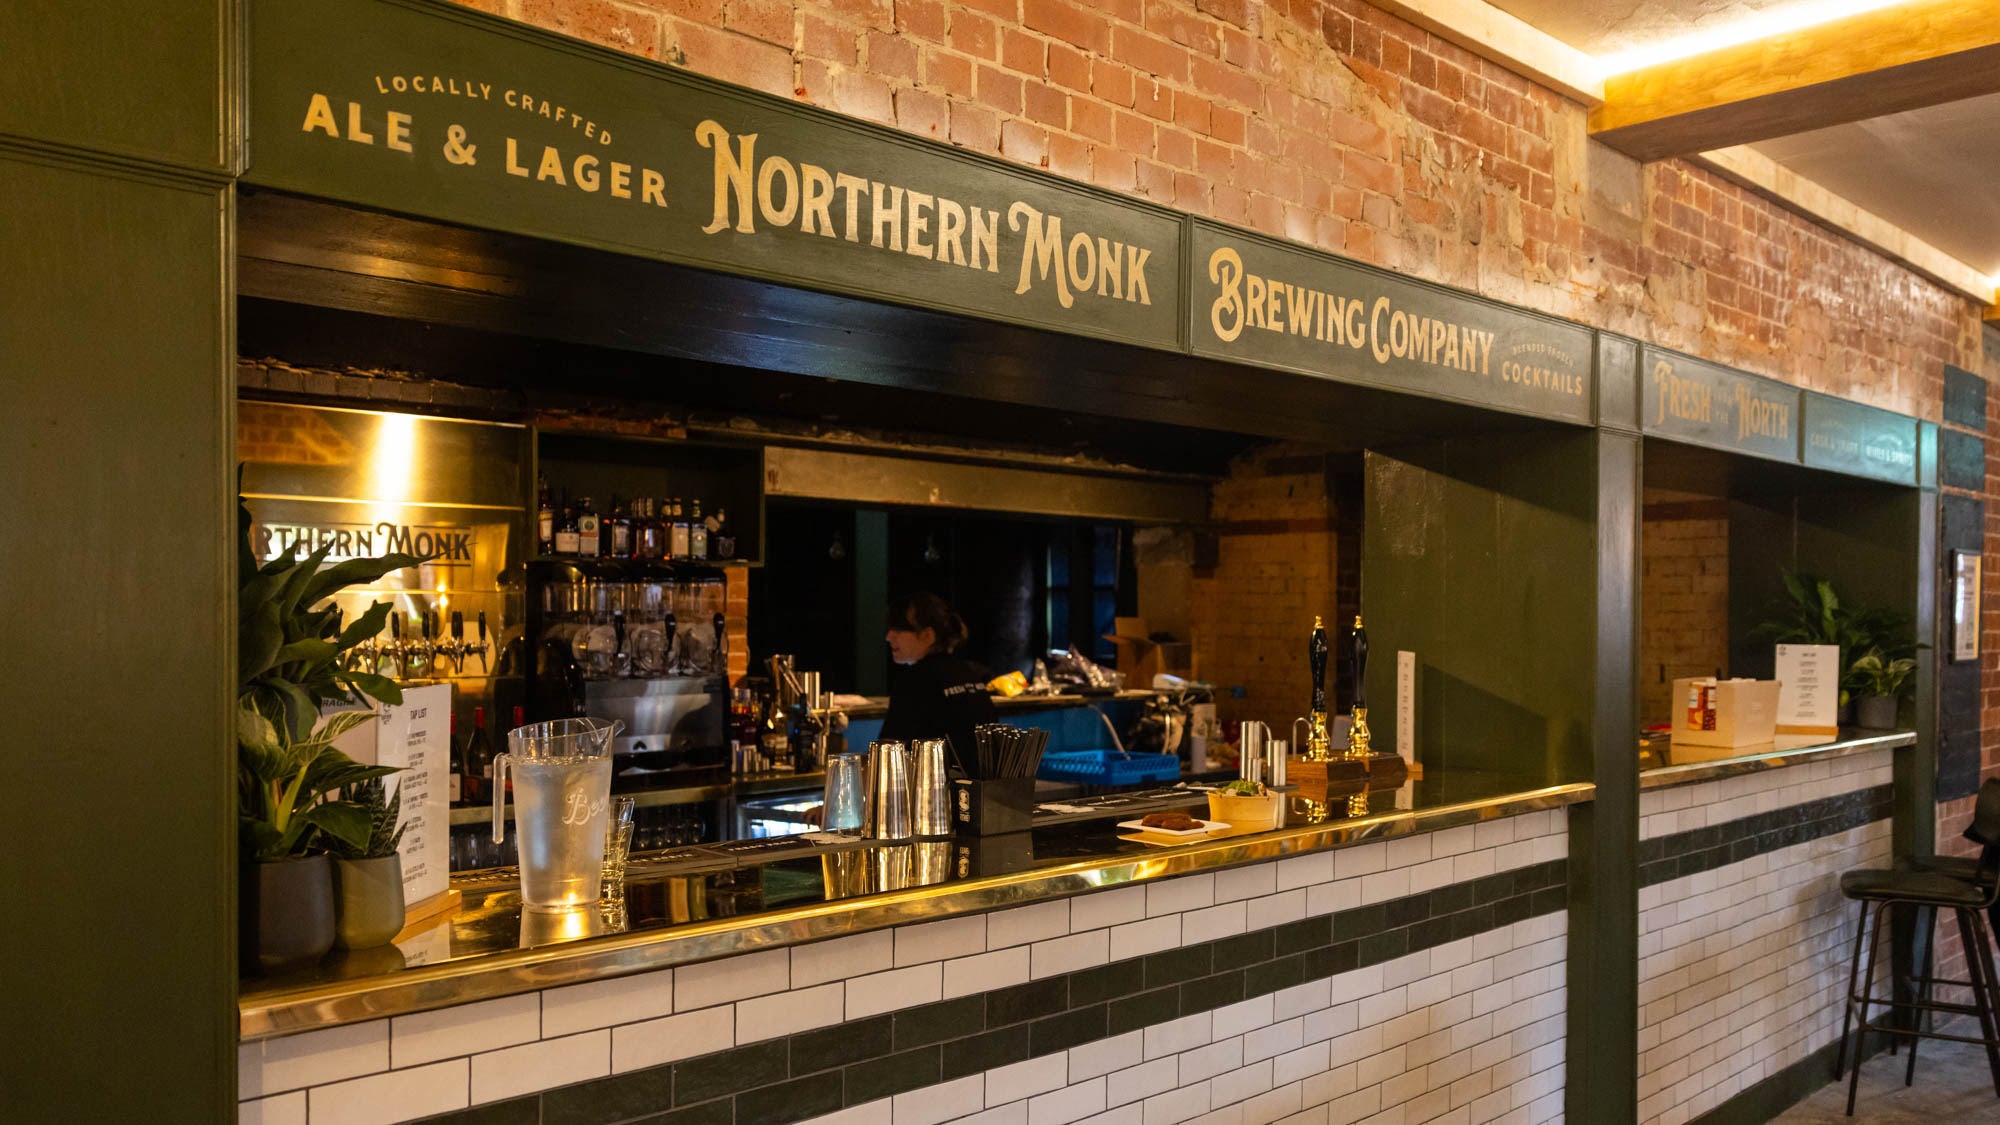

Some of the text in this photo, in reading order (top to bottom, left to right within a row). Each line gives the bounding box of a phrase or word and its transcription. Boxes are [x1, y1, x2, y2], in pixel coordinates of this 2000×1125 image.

[375, 75, 612, 146] LOCALLY CRAFTED
[301, 92, 668, 208] ALE & LAGER
[694, 119, 1152, 309] NORTHERN MONK
[1208, 247, 1495, 376] BREWING COMPANY
[1501, 360, 1583, 397] COCKTAILS
[1653, 360, 1712, 426] FRESH
[1735, 383, 1790, 441] NORTH
[252, 522, 472, 562] RTHERN MONK
